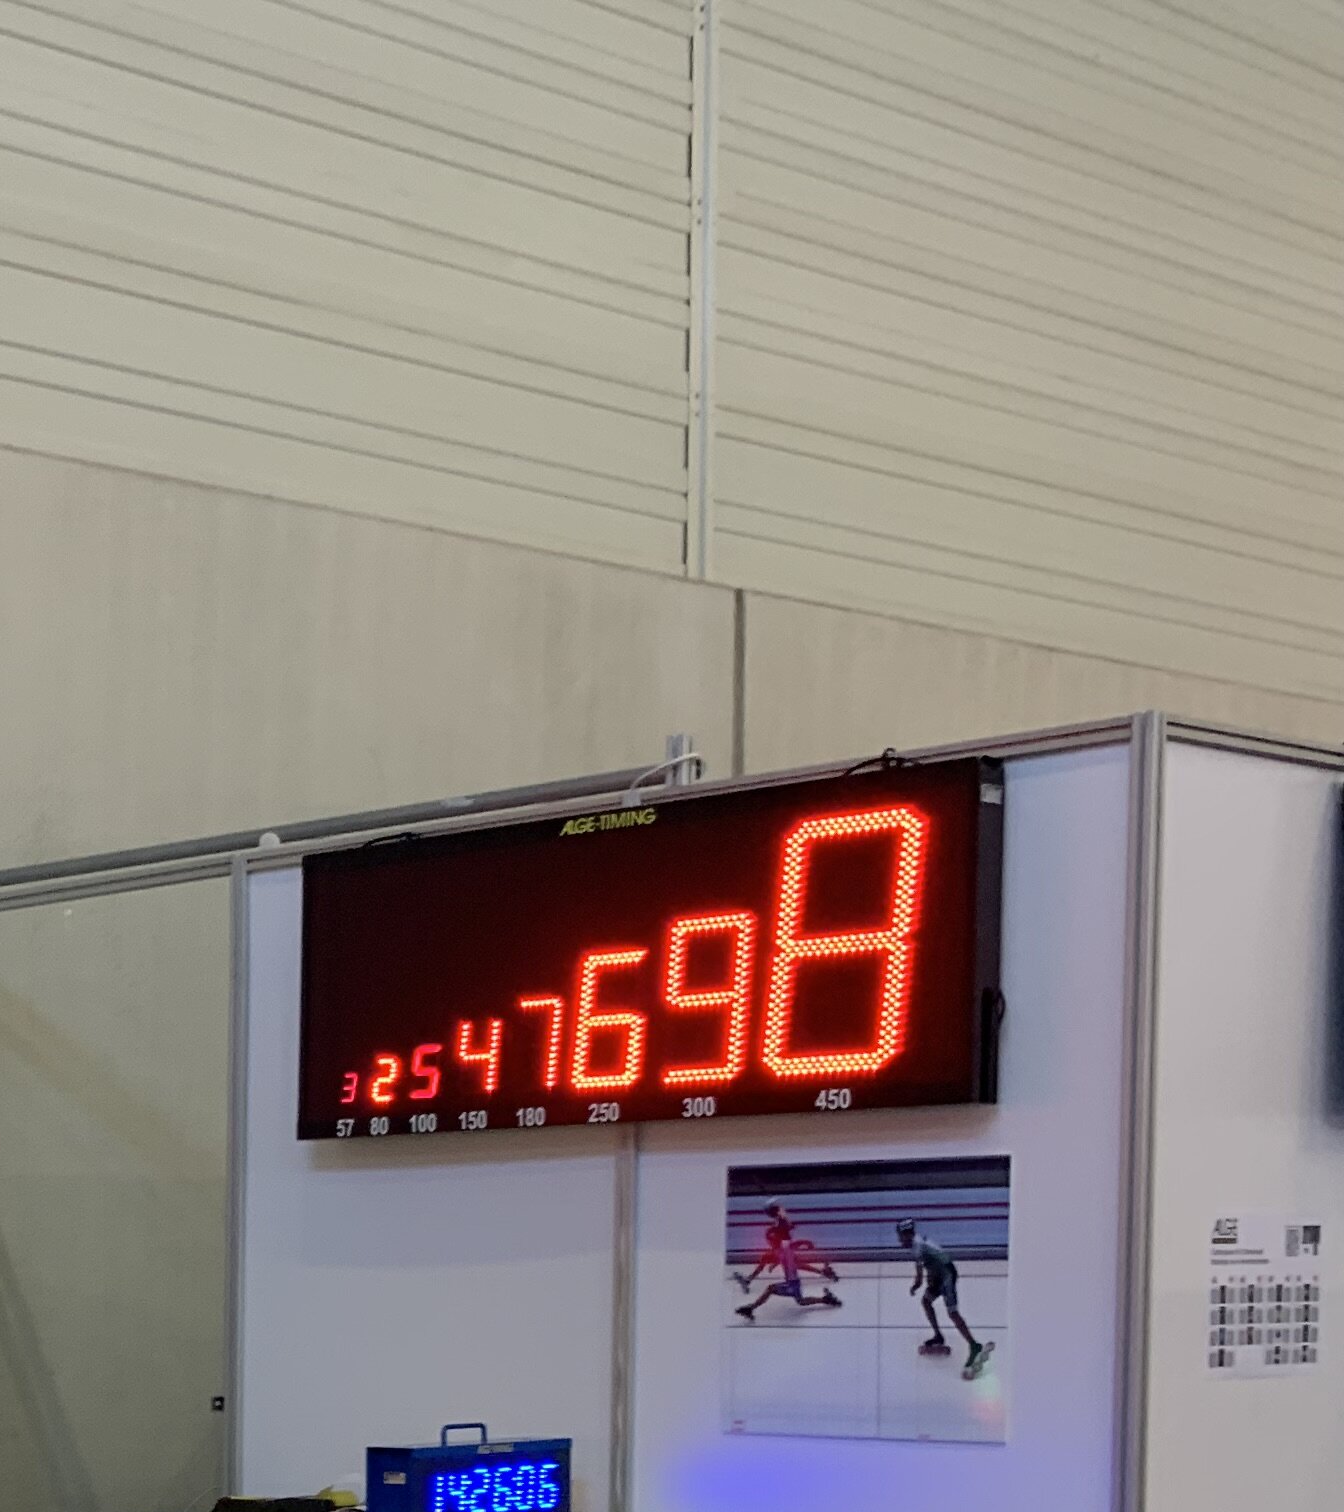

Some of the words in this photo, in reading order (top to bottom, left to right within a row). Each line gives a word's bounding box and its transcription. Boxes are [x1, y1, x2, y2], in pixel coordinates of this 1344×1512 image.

[559, 808, 656, 836] ALGE-TIMING
[336, 1117, 354, 1138] 57
[369, 1114, 389, 1135] 80
[409, 1112, 437, 1133] 100
[458, 1109, 488, 1129] 150
[516, 1106, 546, 1127] 180
[589, 1103, 620, 1123] 250
[682, 1096, 715, 1118] 300
[816, 1089, 852, 1111] 450
